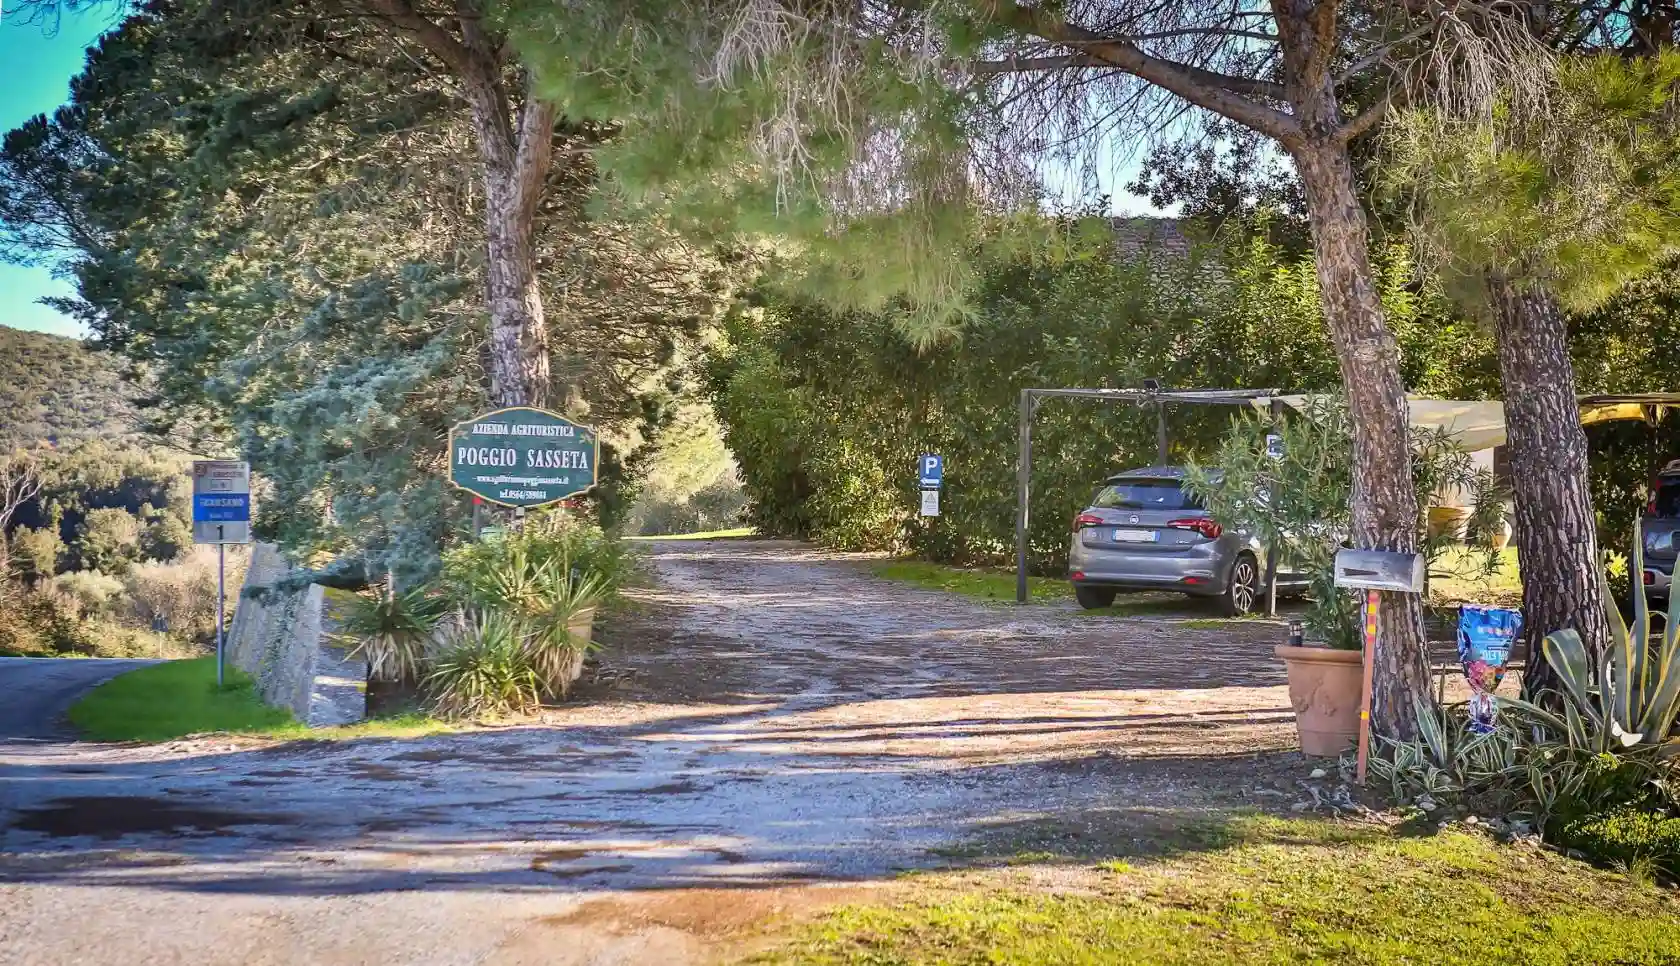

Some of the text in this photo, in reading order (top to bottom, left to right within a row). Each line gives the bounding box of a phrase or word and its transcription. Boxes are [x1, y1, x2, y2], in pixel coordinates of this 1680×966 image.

[472, 423, 574, 437] AZIENDA AGRITURISTICA
[457, 447, 589, 469] POGGIO SASSETA
[925, 457, 938, 475] P
[216, 525, 224, 540] 1
